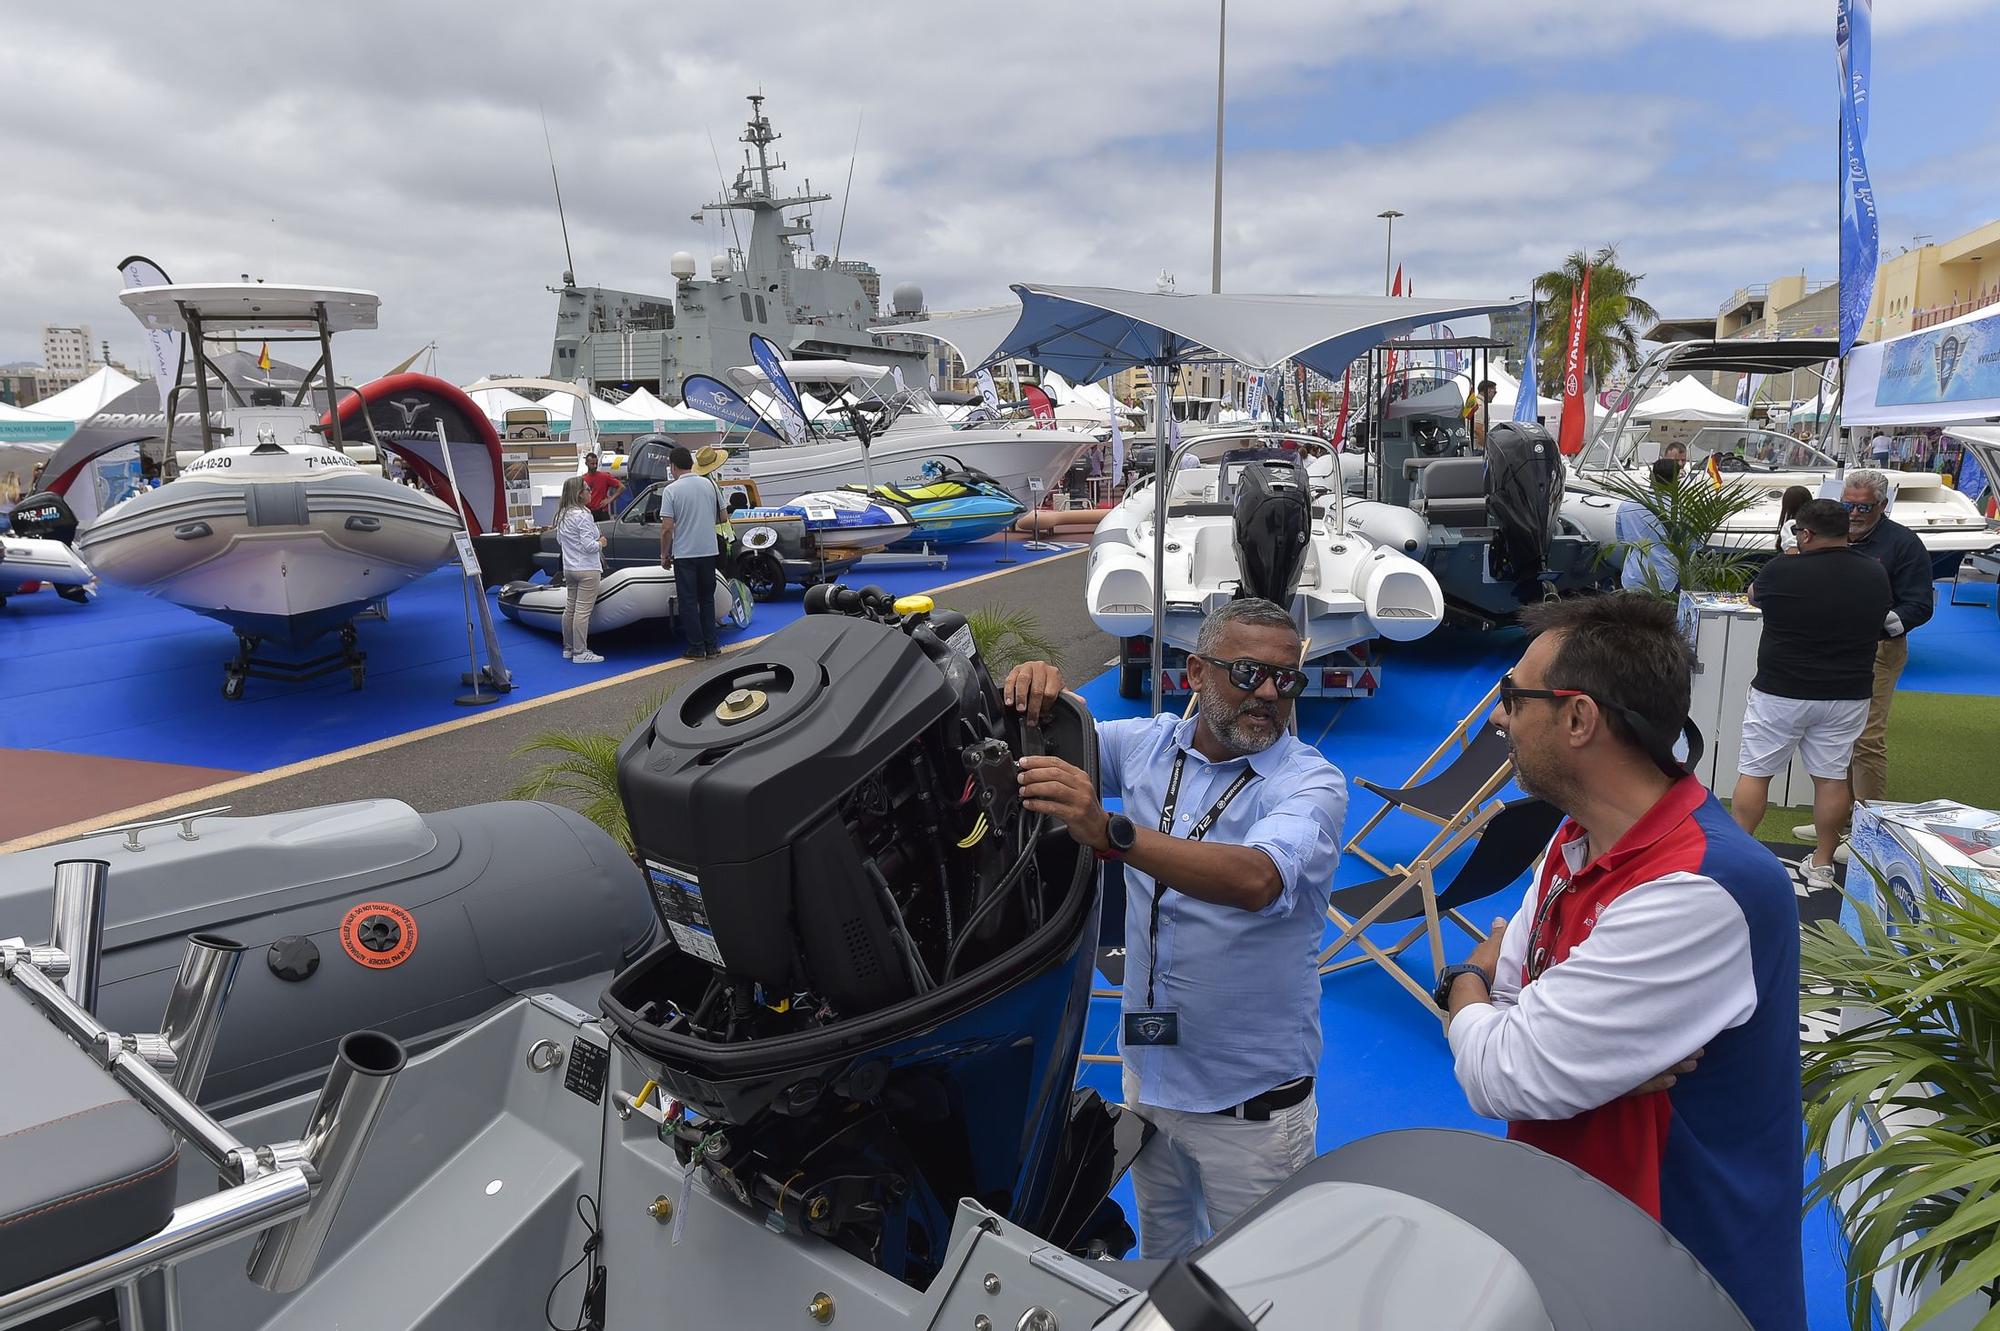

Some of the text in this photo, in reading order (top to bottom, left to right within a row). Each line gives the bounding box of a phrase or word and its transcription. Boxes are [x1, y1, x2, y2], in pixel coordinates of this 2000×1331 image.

[1568, 289, 1586, 372] YAMAHA
[91, 411, 223, 428] PRONATIA
[374, 430, 439, 440] PRONAUTIC
[1170, 768, 1180, 796] MERCURY
[1223, 775, 1247, 802] MERCURY
[1162, 804, 1174, 834] V12
[1189, 814, 1213, 840] V12
